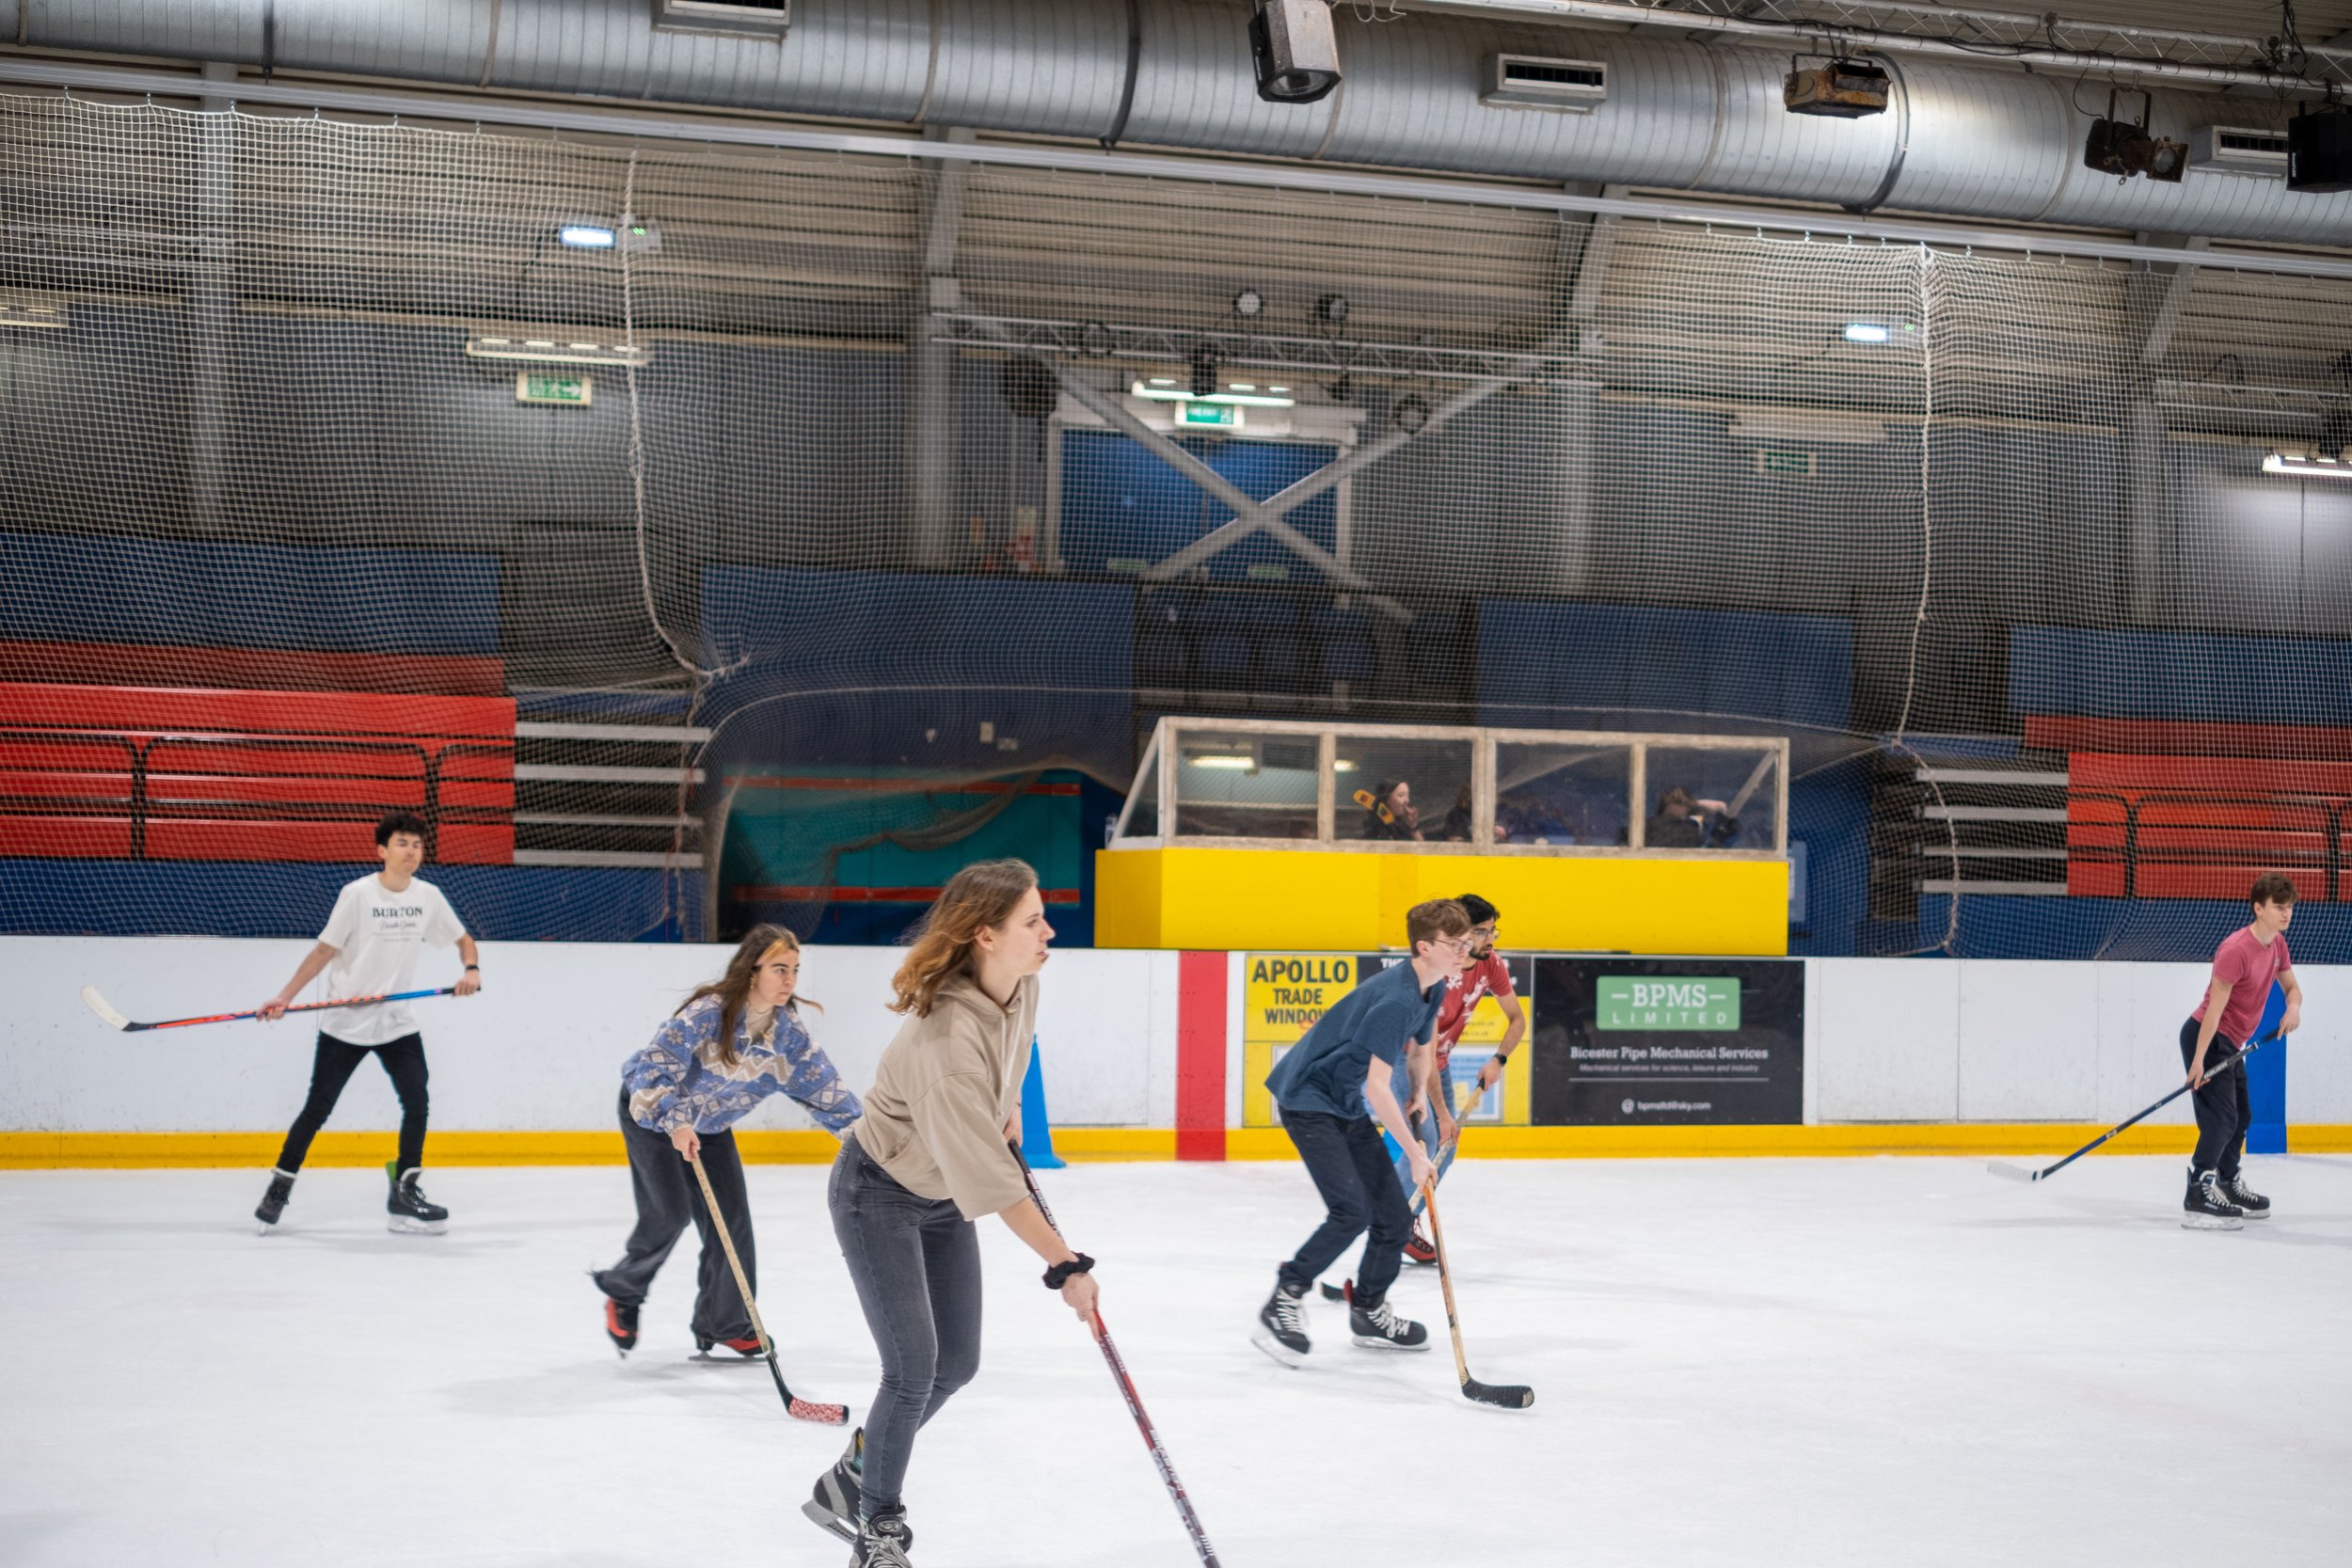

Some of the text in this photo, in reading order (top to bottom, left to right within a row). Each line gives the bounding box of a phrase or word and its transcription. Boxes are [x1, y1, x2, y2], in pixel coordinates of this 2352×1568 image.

[373, 906, 422, 917] BURTON
[1251, 959, 1349, 984] APOLLO
[1272, 988, 1323, 1006] TRADE
[1631, 983, 1707, 1007] BPMS
[1613, 1011, 1726, 1024] LIMITED
[1570, 1046, 1769, 1062] Bicester Pipe Mechanical Services
[1716, 1064, 1730, 1072] and
